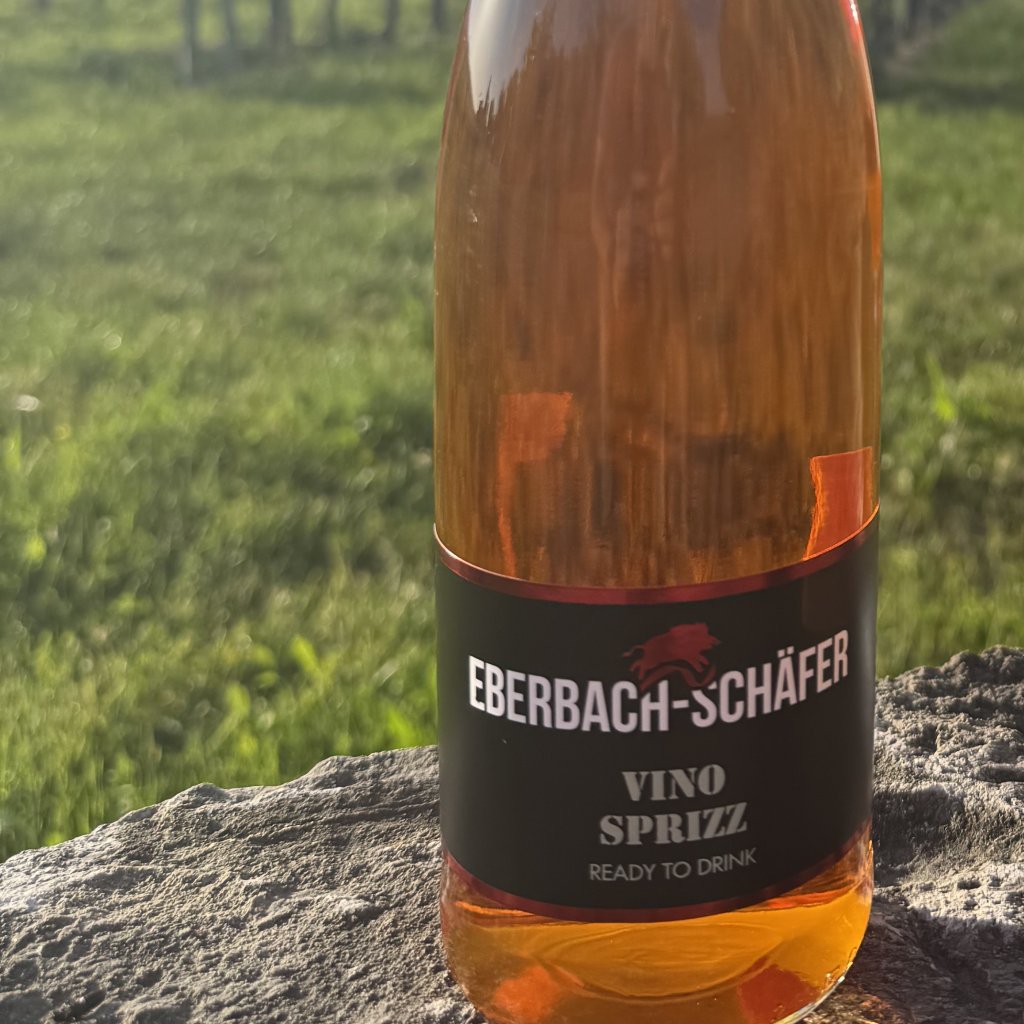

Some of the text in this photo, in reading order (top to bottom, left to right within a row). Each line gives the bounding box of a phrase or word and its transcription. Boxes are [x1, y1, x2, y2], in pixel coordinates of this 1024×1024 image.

[468, 630, 849, 733] EBERBACH-SCHÄFER
[622, 764, 726, 802] VINO
[599, 802, 748, 846] SPRIZZ
[589, 848, 757, 882] READY TO DRINK
